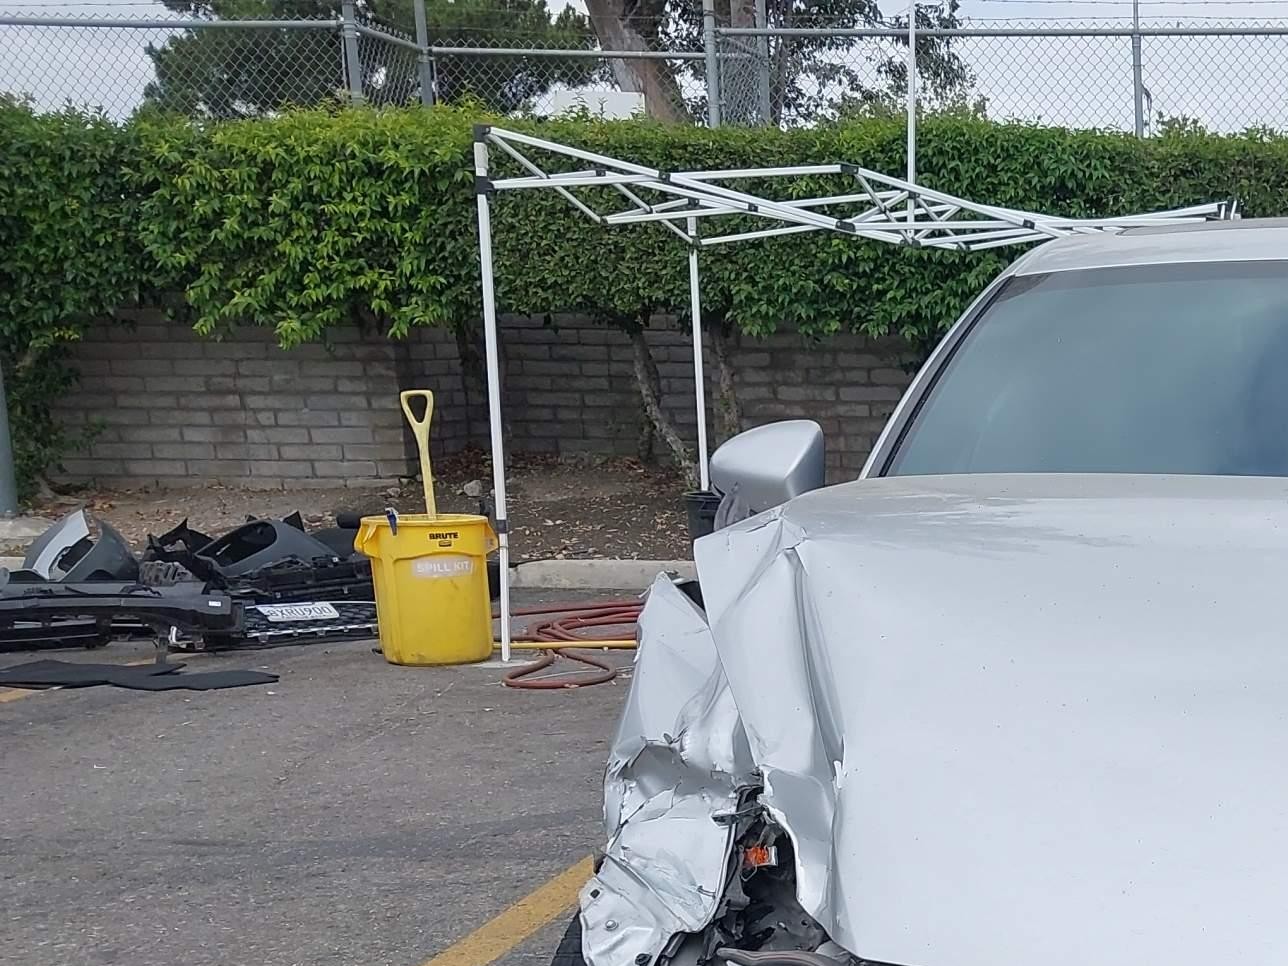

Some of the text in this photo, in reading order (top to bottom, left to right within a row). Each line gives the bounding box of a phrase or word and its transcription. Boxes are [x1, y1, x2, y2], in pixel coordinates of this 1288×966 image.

[429, 532, 458, 540] BRUTE
[417, 560, 470, 573] SPILL KIT
